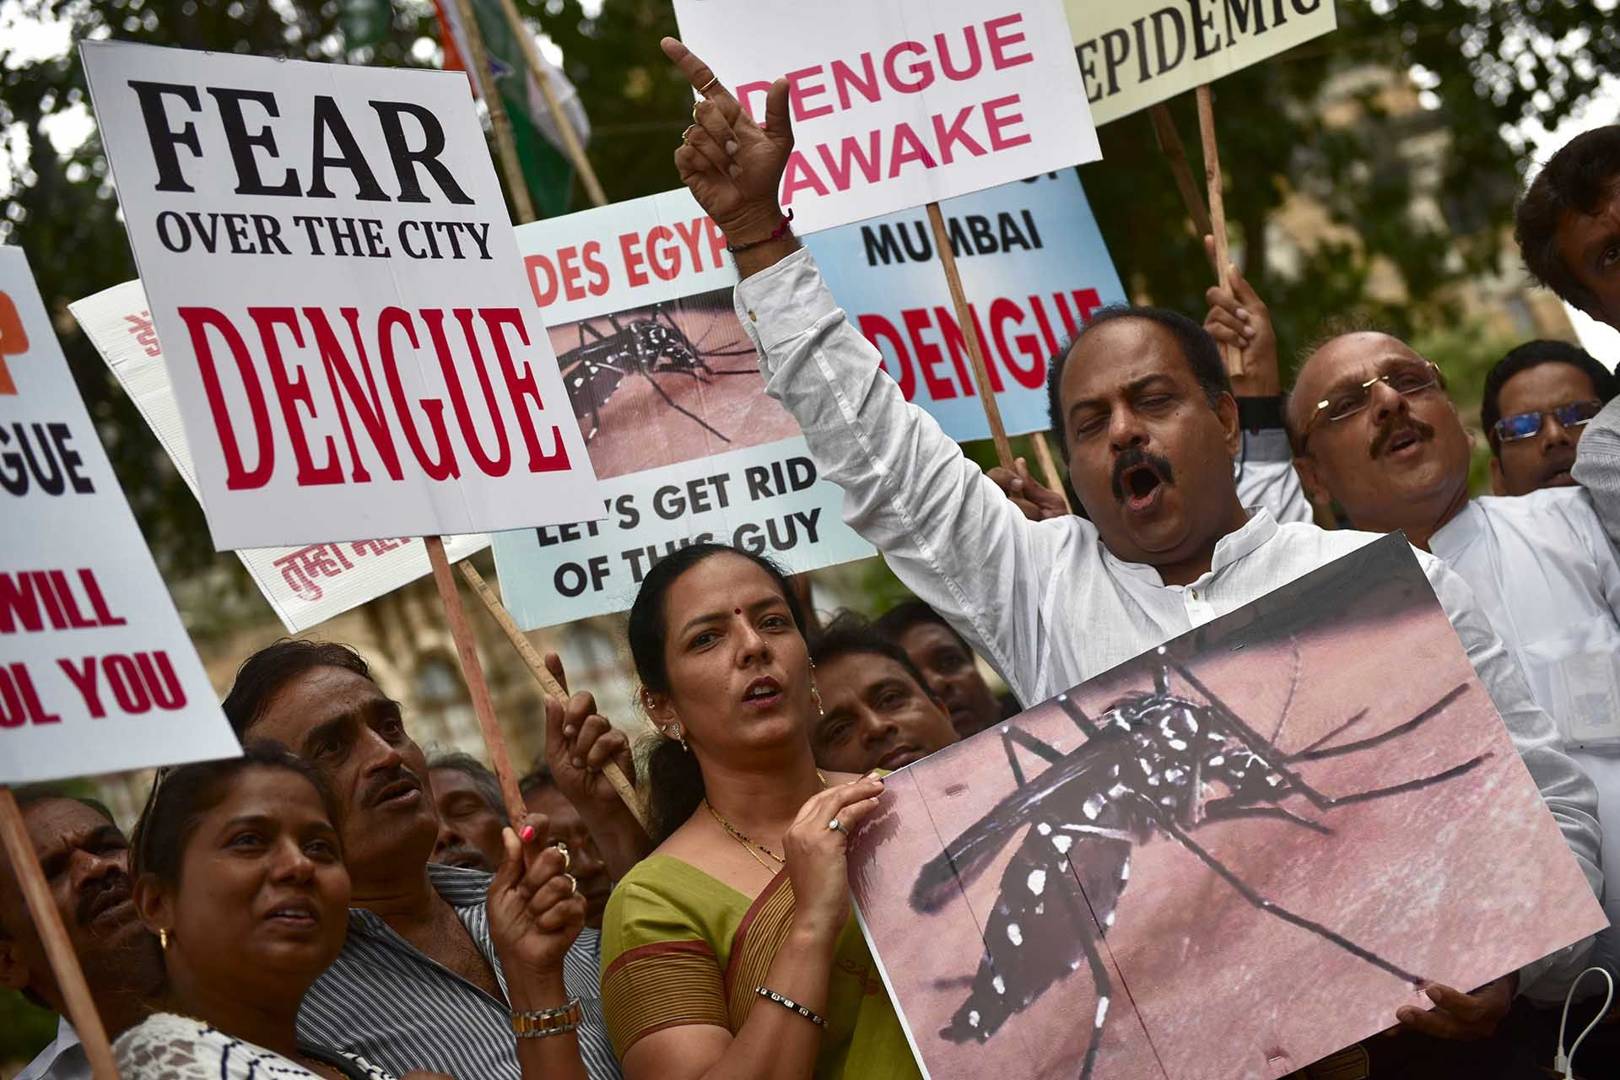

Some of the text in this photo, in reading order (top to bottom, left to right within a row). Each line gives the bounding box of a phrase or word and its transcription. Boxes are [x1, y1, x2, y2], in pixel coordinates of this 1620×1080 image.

[736, 12, 1034, 130] DENGUE
[1074, 0, 1321, 105] EPIDEM
[127, 79, 475, 205] FEAR
[780, 93, 1032, 206] AWAKE
[156, 210, 493, 260] OVER THE CITY
[861, 209, 1043, 267] MUMBAI
[177, 306, 572, 490] DENGUE
[653, 472, 730, 521] GET
[744, 456, 818, 501] RID
[553, 555, 610, 598] OF
[733, 507, 822, 556] GUY
[56, 650, 188, 720] YOU
